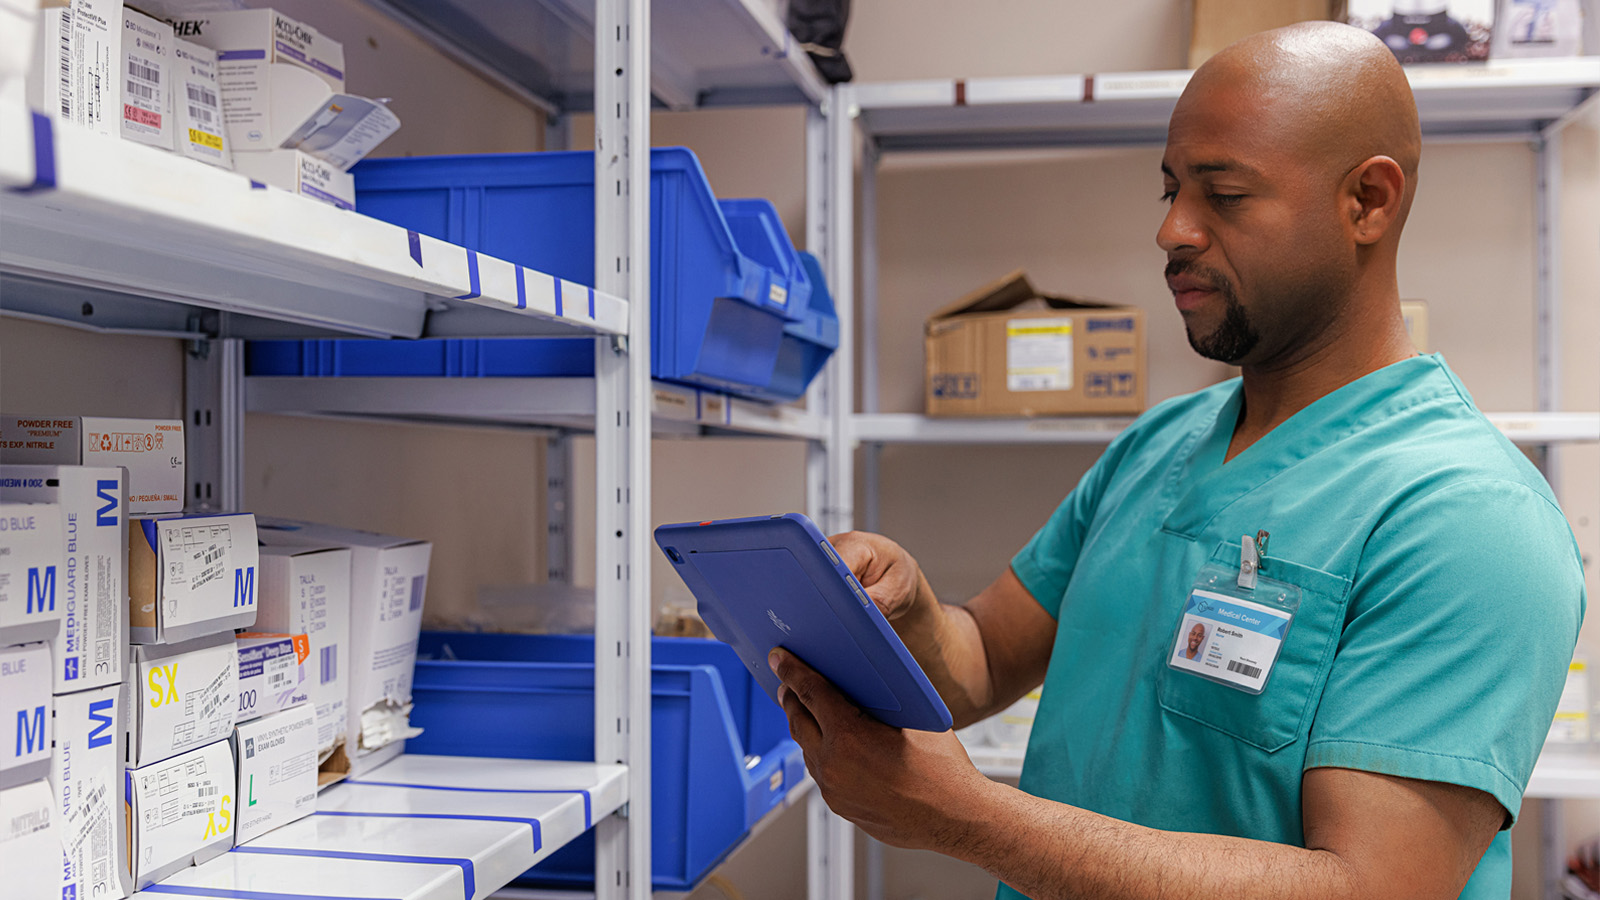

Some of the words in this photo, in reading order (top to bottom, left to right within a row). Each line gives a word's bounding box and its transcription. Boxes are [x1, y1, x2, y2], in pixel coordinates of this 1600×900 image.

[166, 18, 204, 36] HEK
[17, 419, 52, 428] POWDER
[53, 420, 73, 429] FREE
[9, 441, 25, 449] EXP.
[26, 441, 55, 449] NITRILE
[96, 480, 118, 527] M
[10, 516, 36, 531] BLUE
[68, 513, 77, 552] BLUE
[26, 565, 56, 615] M
[233, 566, 254, 607] M
[66, 557, 77, 653] MEDIGUARD
[1217, 608, 1241, 620] Medical
[1241, 614, 1261, 626] Center
[1217, 626, 1231, 636] Robert
[1231, 630, 1243, 638] Smith
[298, 639, 304, 653] S
[2, 659, 26, 676] BLUE
[238, 689, 256, 711] 100
[15, 705, 46, 757] M
[88, 698, 114, 749] M
[258, 741, 270, 752] EXAM
[270, 736, 285, 748] GLOVES
[63, 740, 71, 781] BLUE
[248, 774, 257, 807] L
